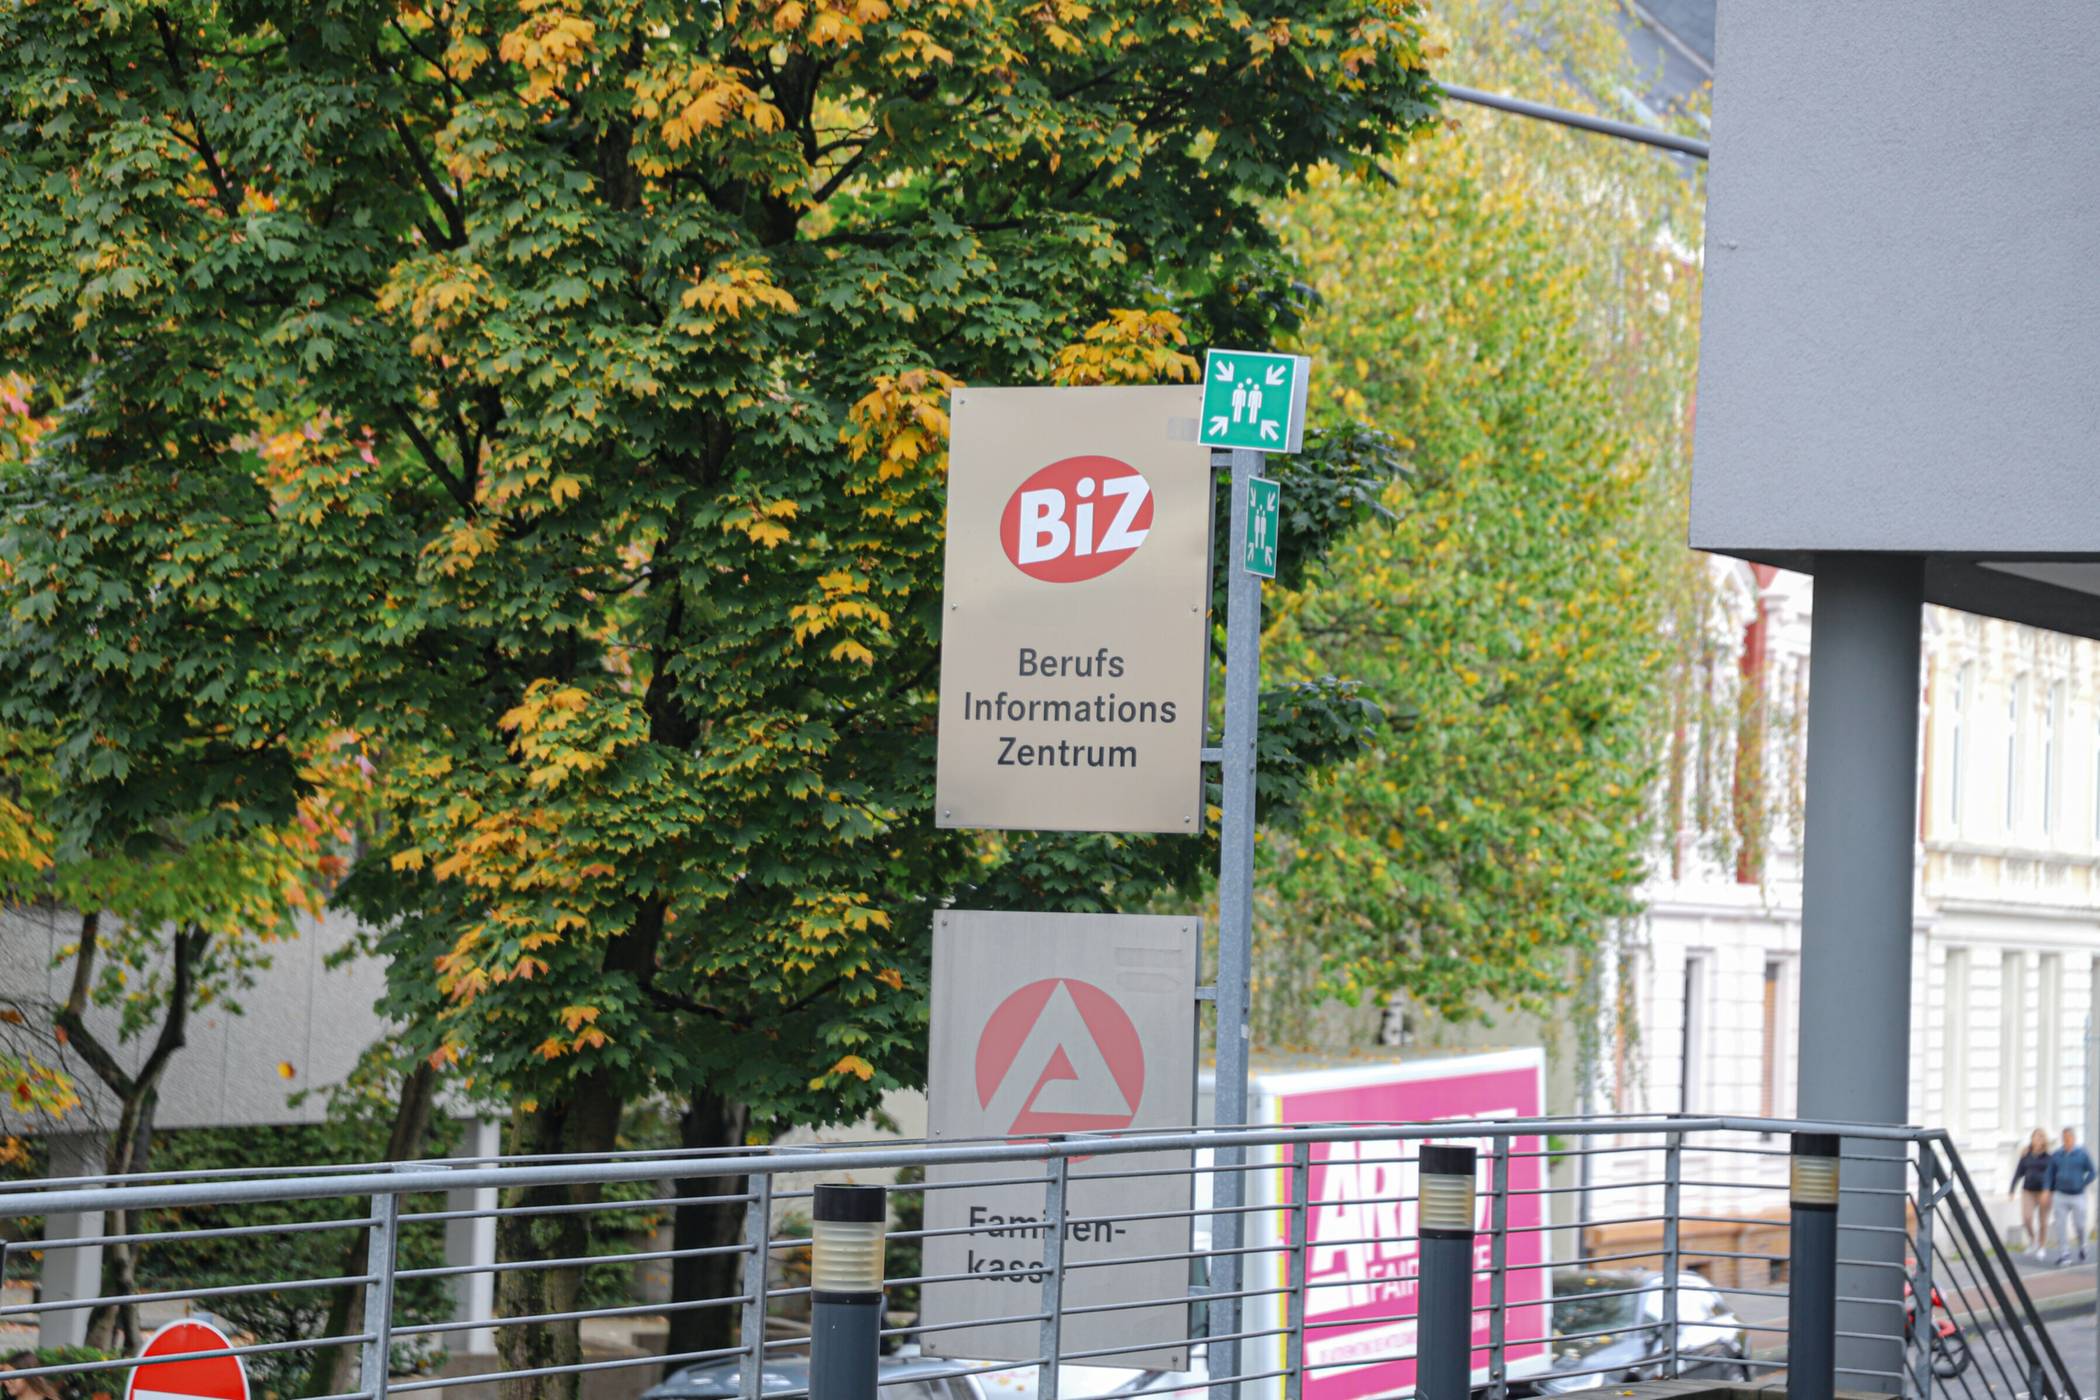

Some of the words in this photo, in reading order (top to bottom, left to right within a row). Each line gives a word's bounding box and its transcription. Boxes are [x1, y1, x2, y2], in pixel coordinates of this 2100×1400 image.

[1018, 474, 1150, 565] BiZ
[1018, 647, 1125, 678] Berufs
[964, 691, 1177, 724] Informations
[997, 736, 1137, 768] Zentrum
[968, 1205, 1126, 1243] Famien-
[967, 1249, 1066, 1284] kass
